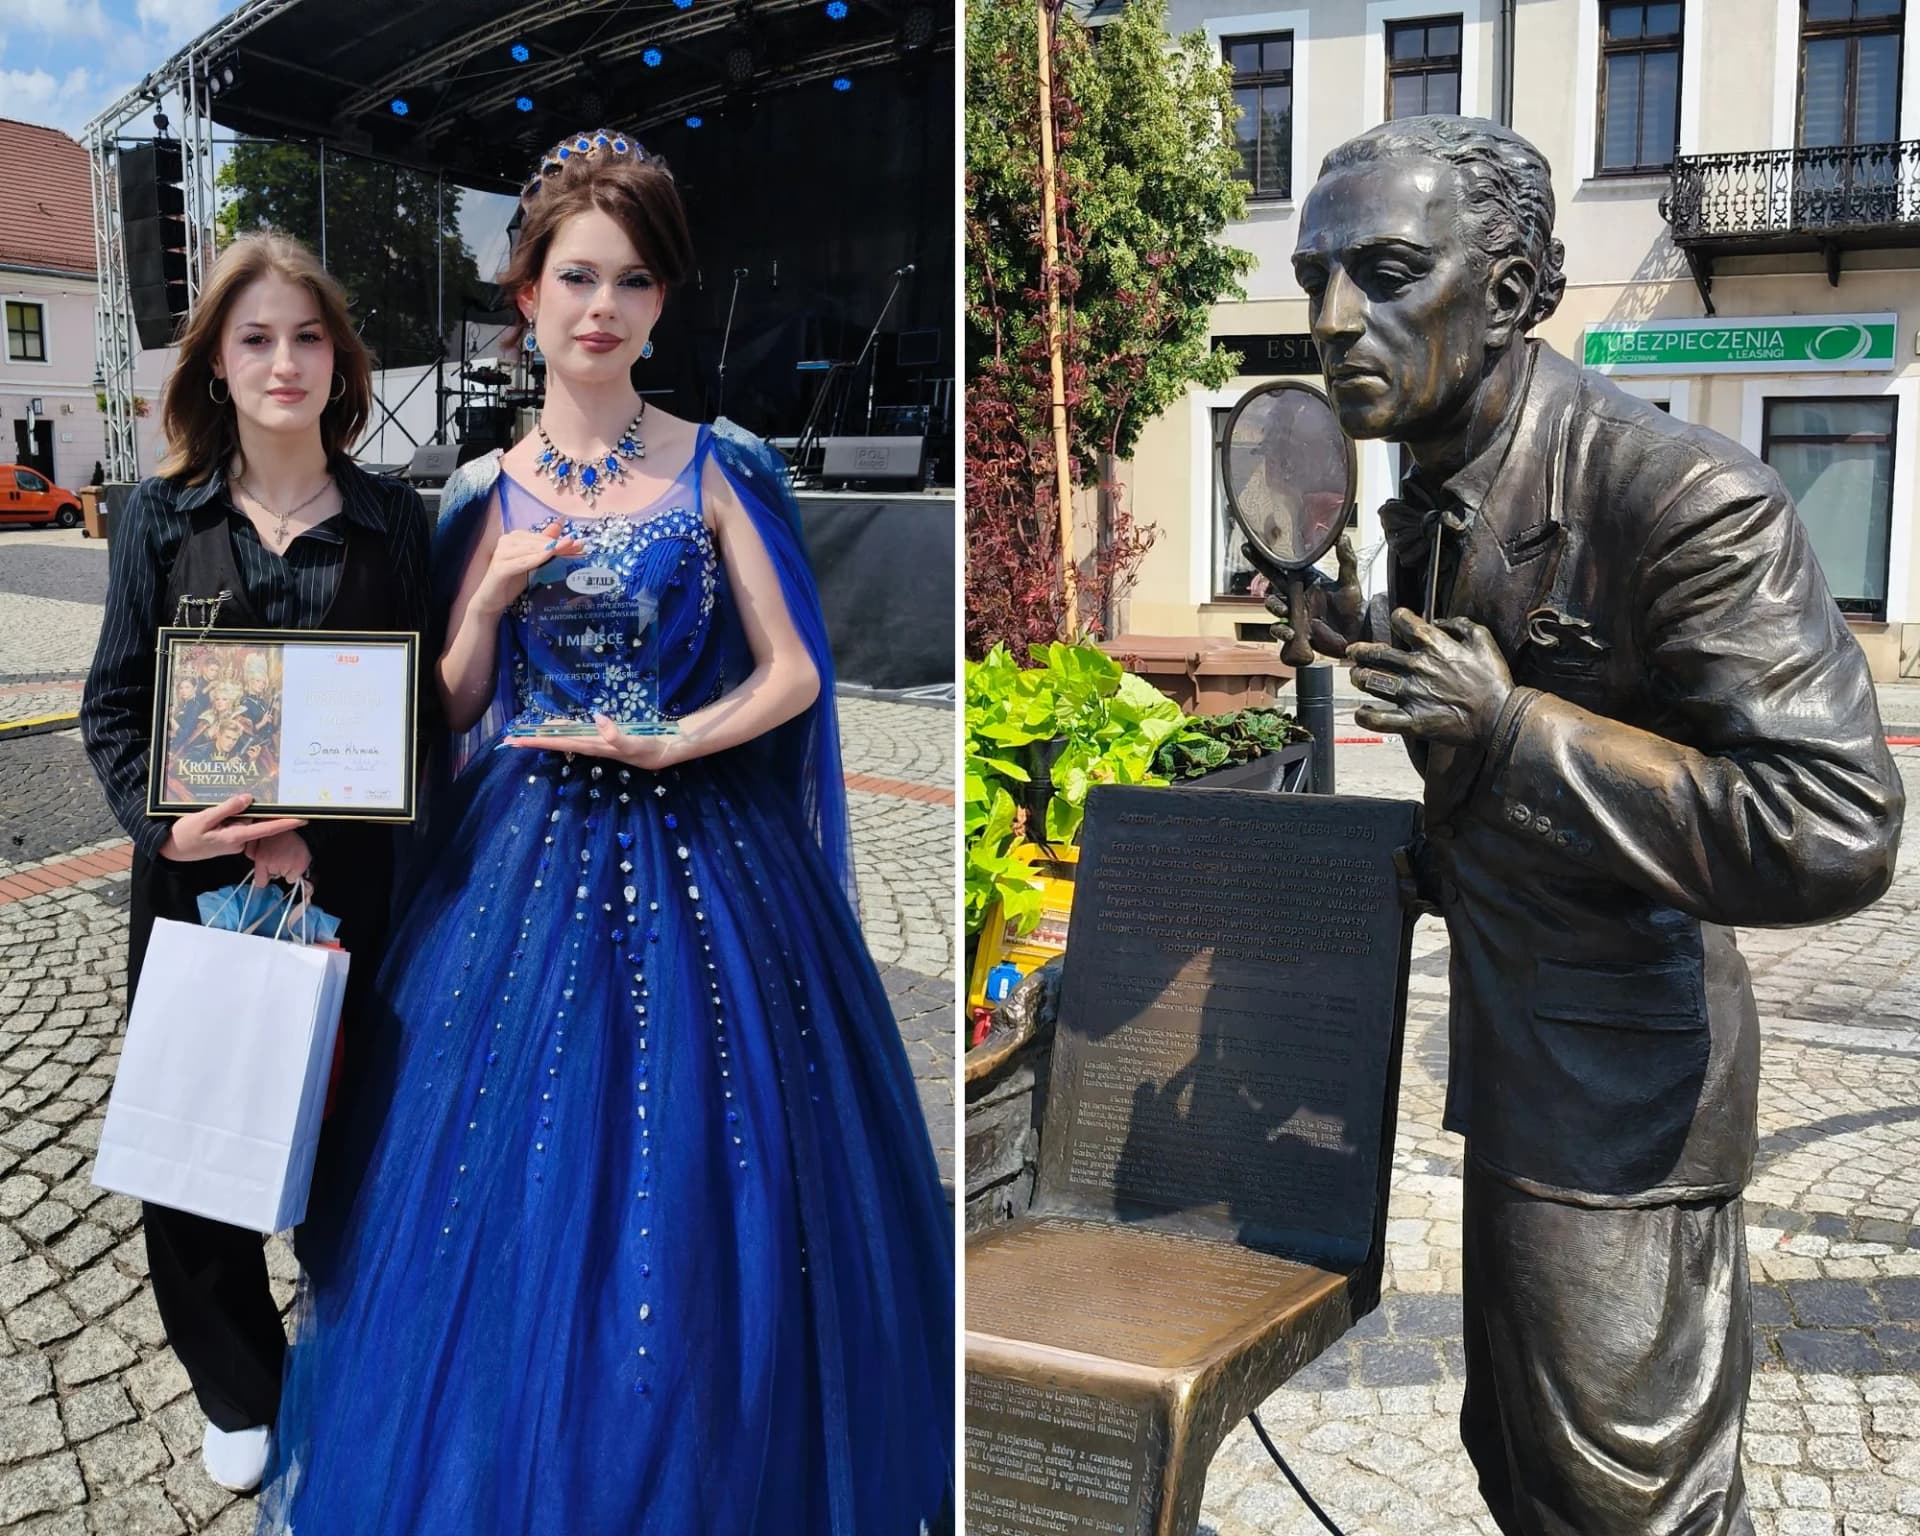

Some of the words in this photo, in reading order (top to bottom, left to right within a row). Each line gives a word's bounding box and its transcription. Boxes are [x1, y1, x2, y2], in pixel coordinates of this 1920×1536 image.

[1607, 330, 1785, 352] UBEZPIECZENIA
[1735, 349, 1785, 359] LEASINGI
[566, 632, 625, 647] MIEJSCE
[178, 758, 260, 776] KRÓLEWSKA
[190, 774, 247, 785] FRYZURA
